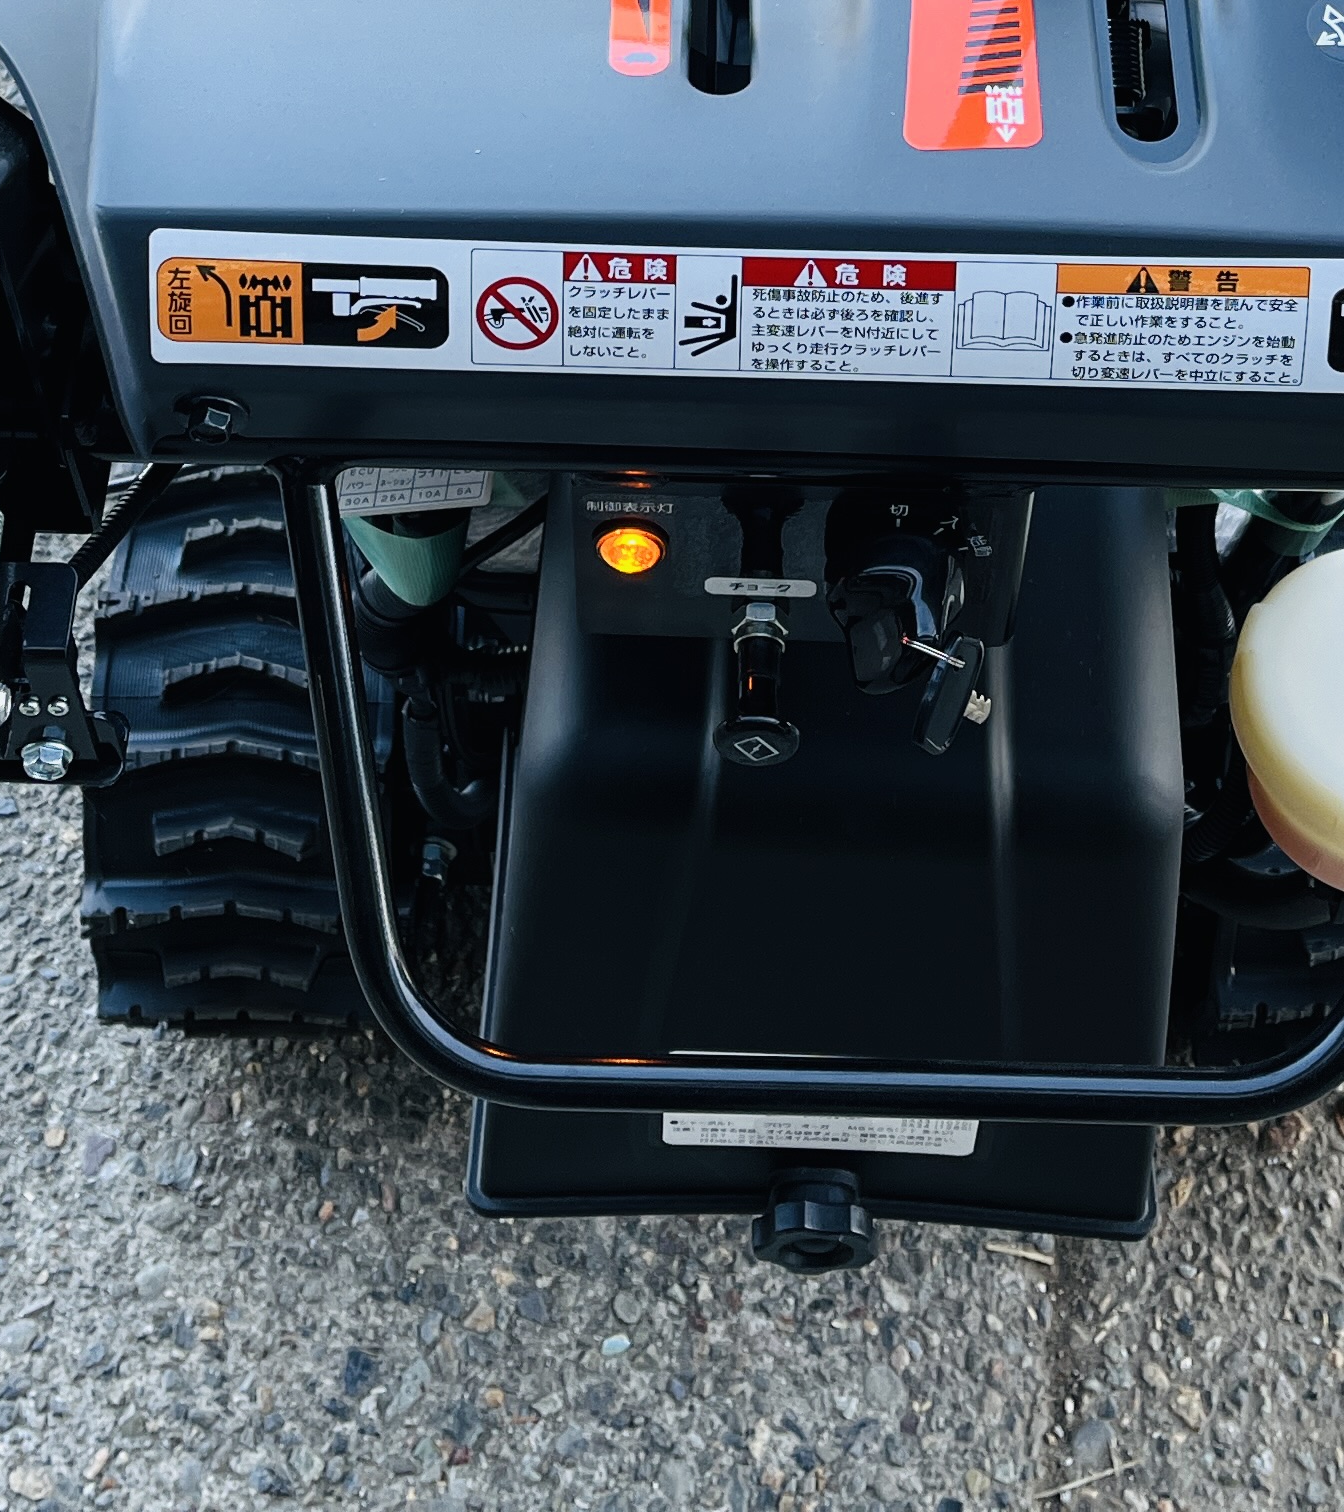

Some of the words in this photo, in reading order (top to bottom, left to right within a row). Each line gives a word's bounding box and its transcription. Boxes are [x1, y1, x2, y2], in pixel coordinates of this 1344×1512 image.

[607, 257, 668, 280] 危険
[835, 263, 908, 287] 危険
[1168, 270, 1239, 292] 警告
[167, 267, 192, 334] 左旋回
[568, 285, 671, 300] クラッチレバー
[752, 288, 944, 306] 死傷事故防止のため、後進す
[568, 305, 670, 320] を固定したまま
[753, 306, 935, 323] るときは必ず後ろを確認し、
[1076, 314, 1244, 330] で正しい作業をすること。
[567, 325, 655, 339] 絶対に運転を
[751, 323, 940, 341] 主変速レバーをN付近にして
[569, 345, 647, 359] しないこと。
[751, 341, 941, 357] ゆっくり走行クラッチレバー
[751, 358, 859, 373] を操作すること。
[1074, 349, 1293, 366] するときは、すべてのクラッチを
[1071, 366, 1300, 384] 切り変速レバーを中立にすること。
[344, 496, 369, 505] 30A
[419, 491, 441, 499] 10A
[586, 500, 674, 514] 制御表示灯
[890, 504, 909, 516] 切
[729, 582, 791, 593] チョーク
